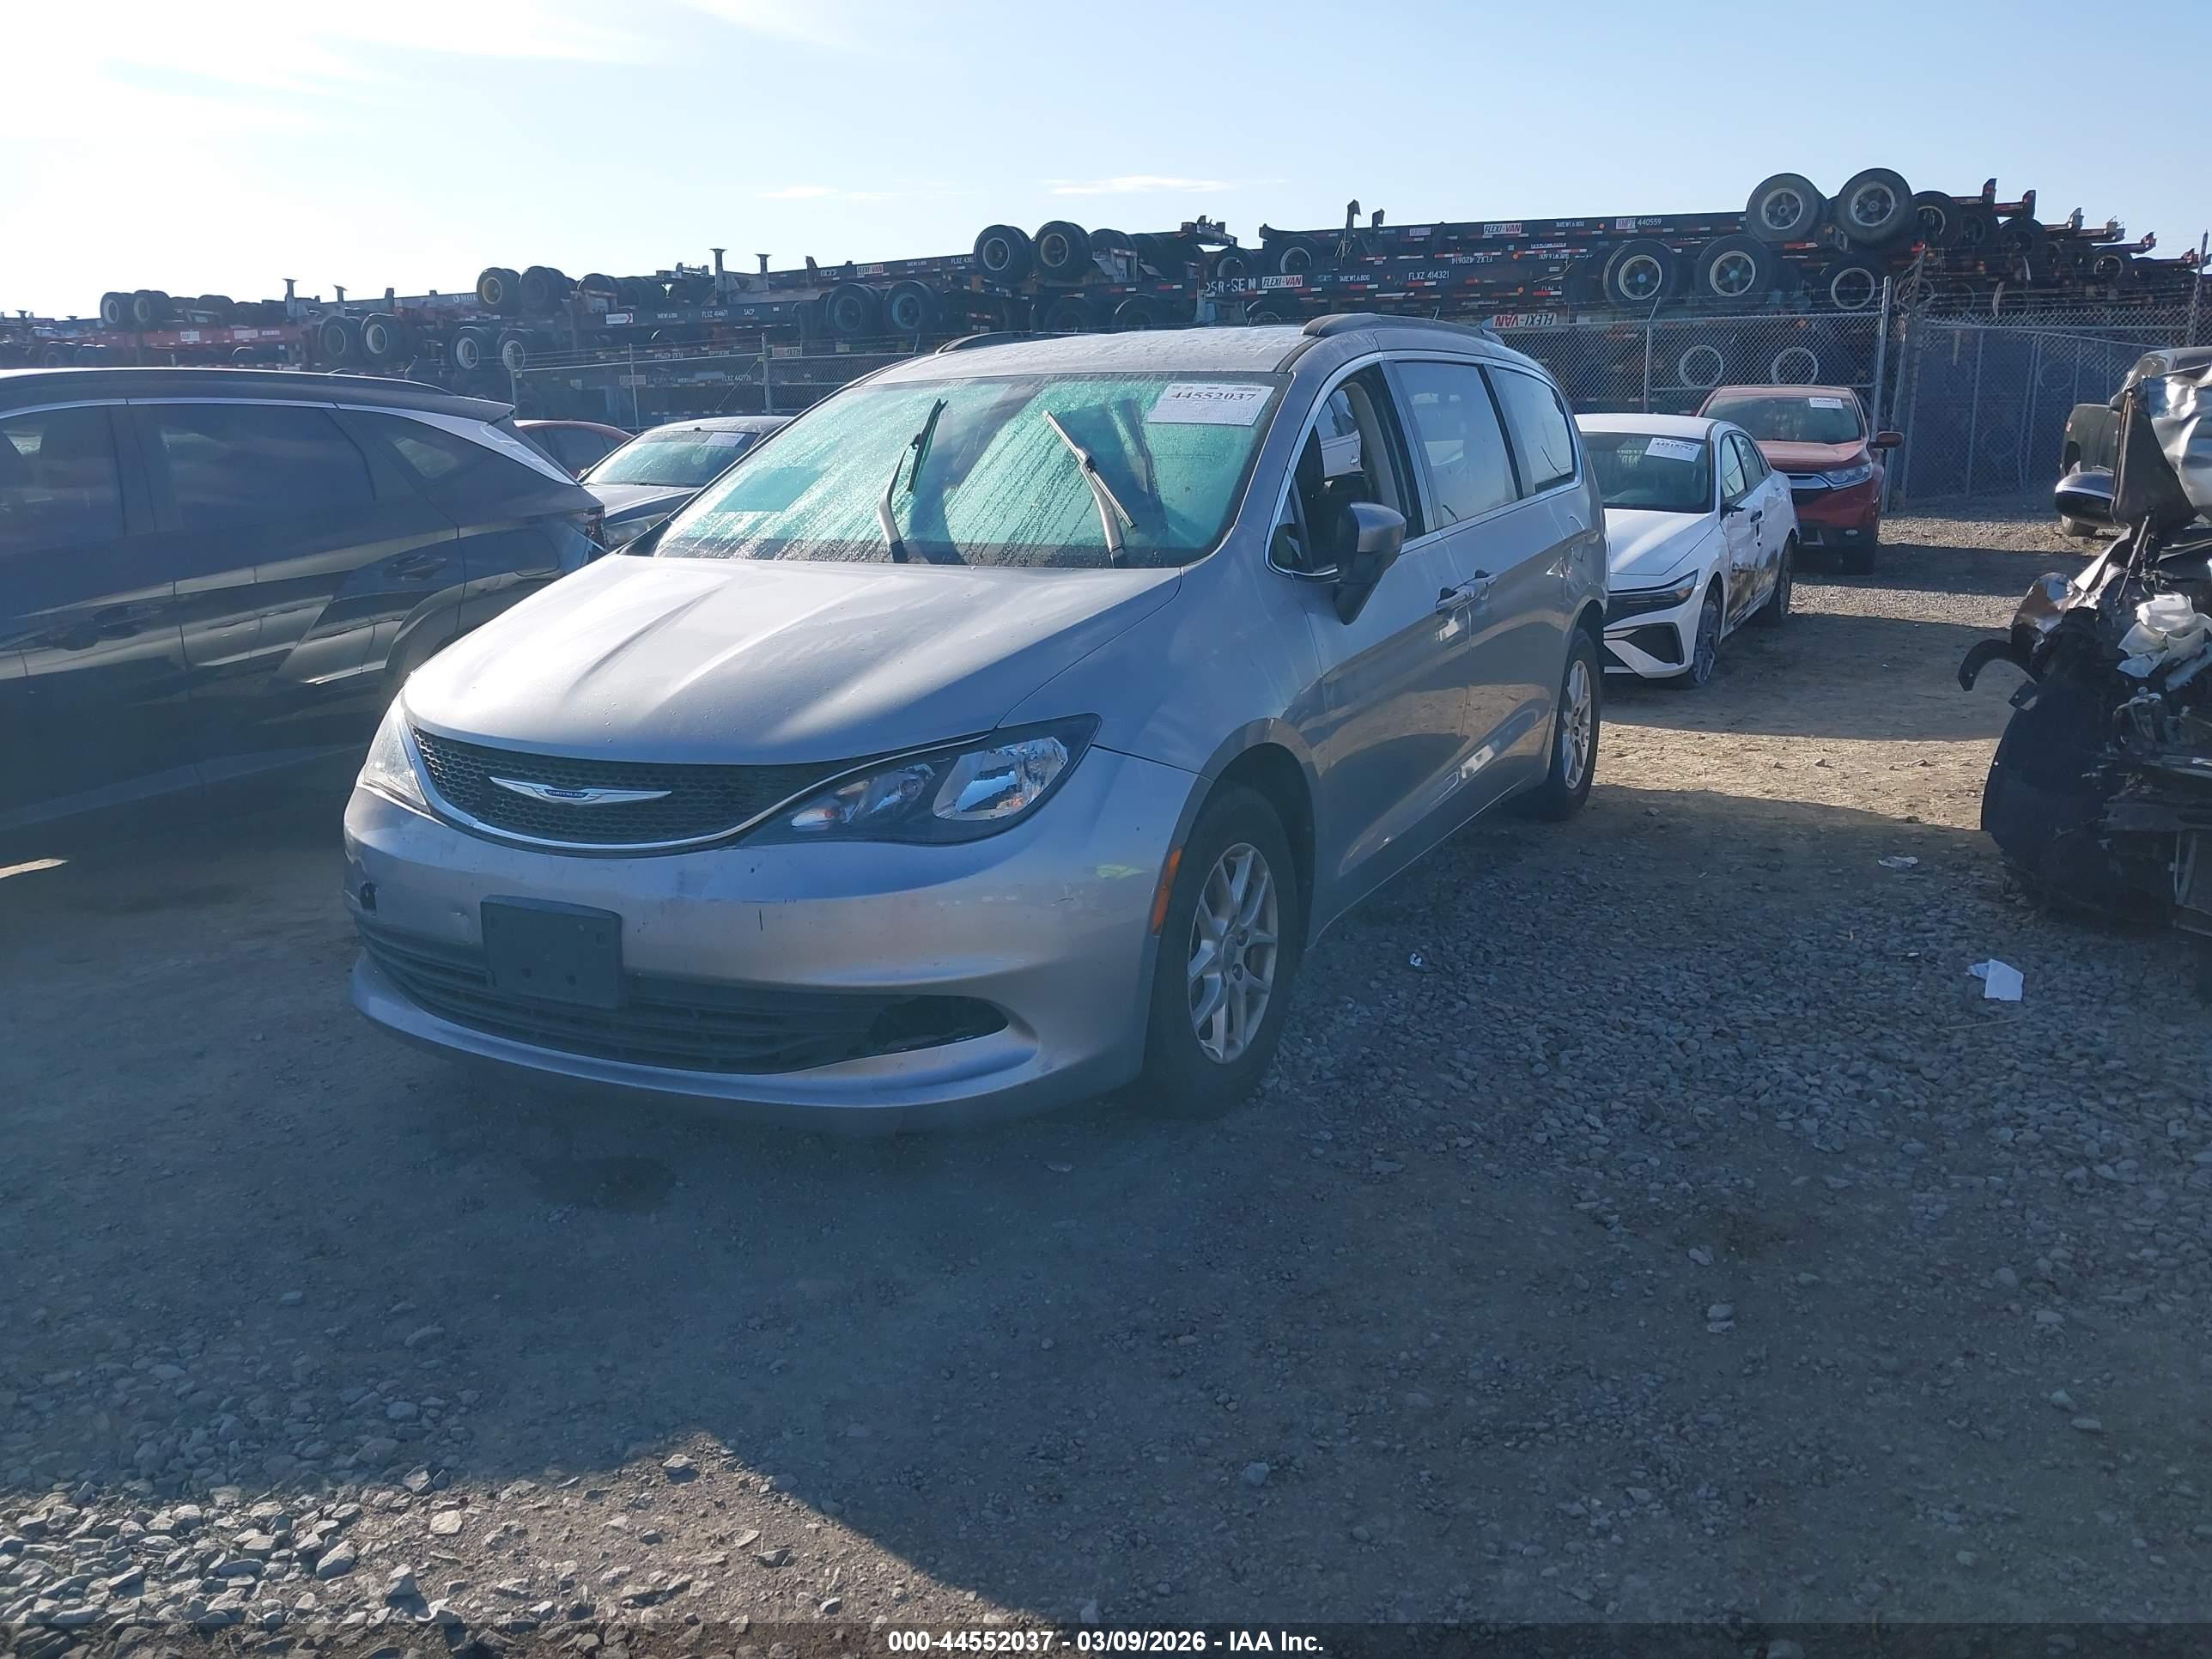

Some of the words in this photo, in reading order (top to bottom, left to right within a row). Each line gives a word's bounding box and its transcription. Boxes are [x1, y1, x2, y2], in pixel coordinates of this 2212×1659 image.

[1638, 218, 1662, 227] 440559
[1484, 224, 1522, 234] FLEXI-VAN
[1408, 272, 1425, 281] FLXZ
[1426, 270, 1449, 280] 414321
[1263, 276, 1302, 287] FLEXI-VAN
[1494, 313, 1555, 327] FLEXI-VAN
[1171, 392, 1257, 401] 44552037
